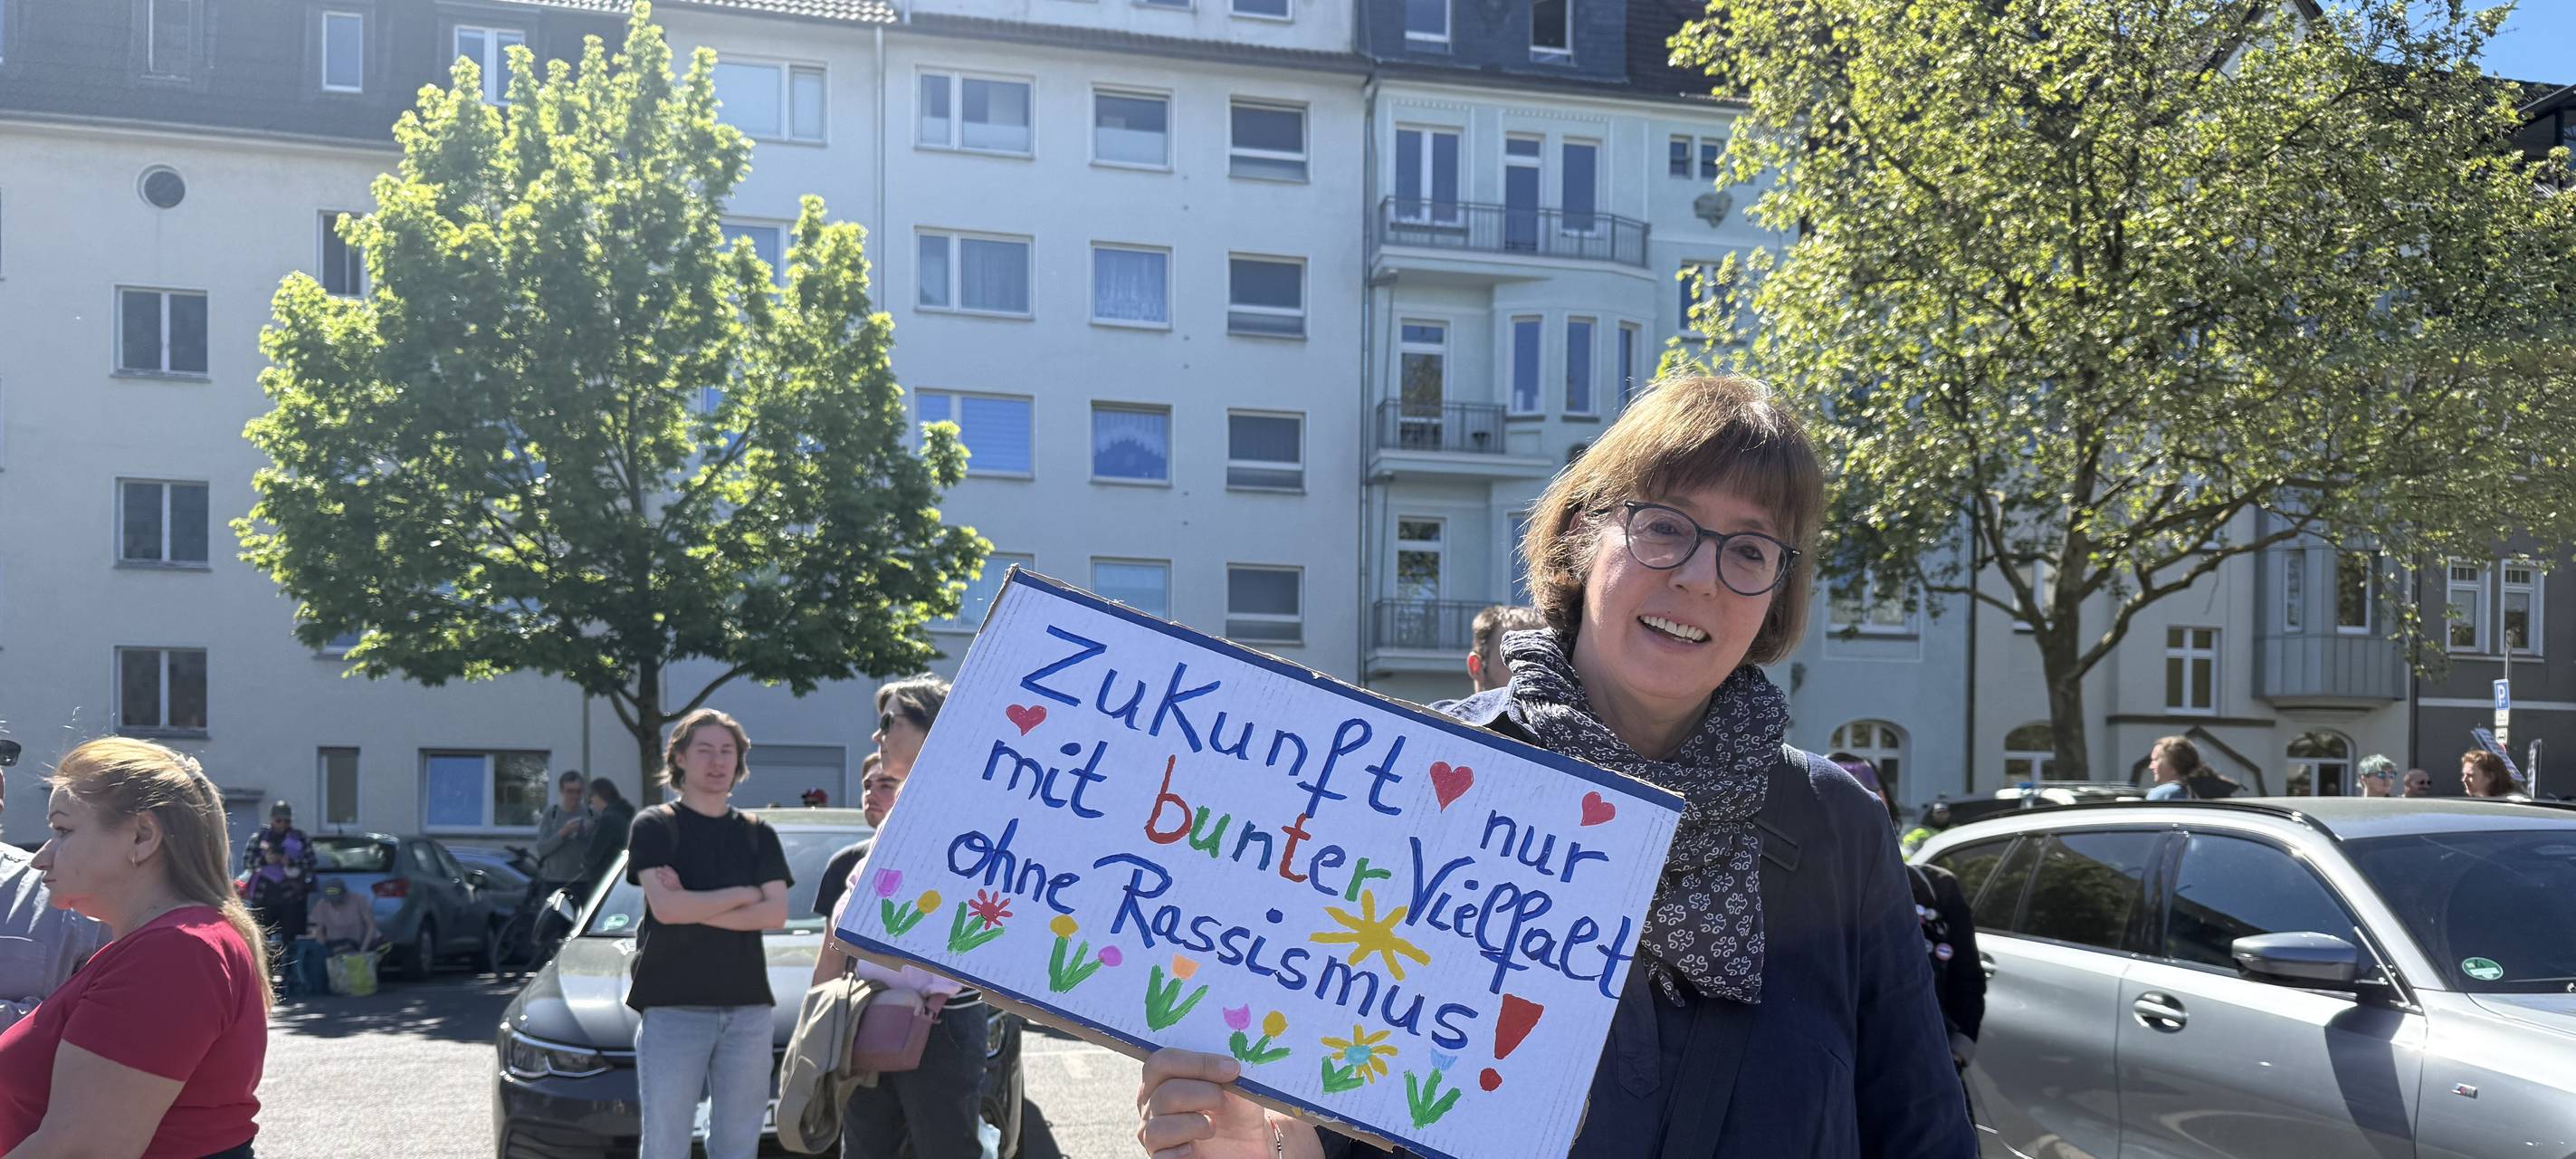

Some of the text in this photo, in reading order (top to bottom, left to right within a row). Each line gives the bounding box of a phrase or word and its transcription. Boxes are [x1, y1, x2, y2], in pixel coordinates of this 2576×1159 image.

[947, 816, 1082, 915] ohne
[981, 739, 1634, 1000] mit bunter Vielfalt
[1480, 809, 1610, 884] nur
